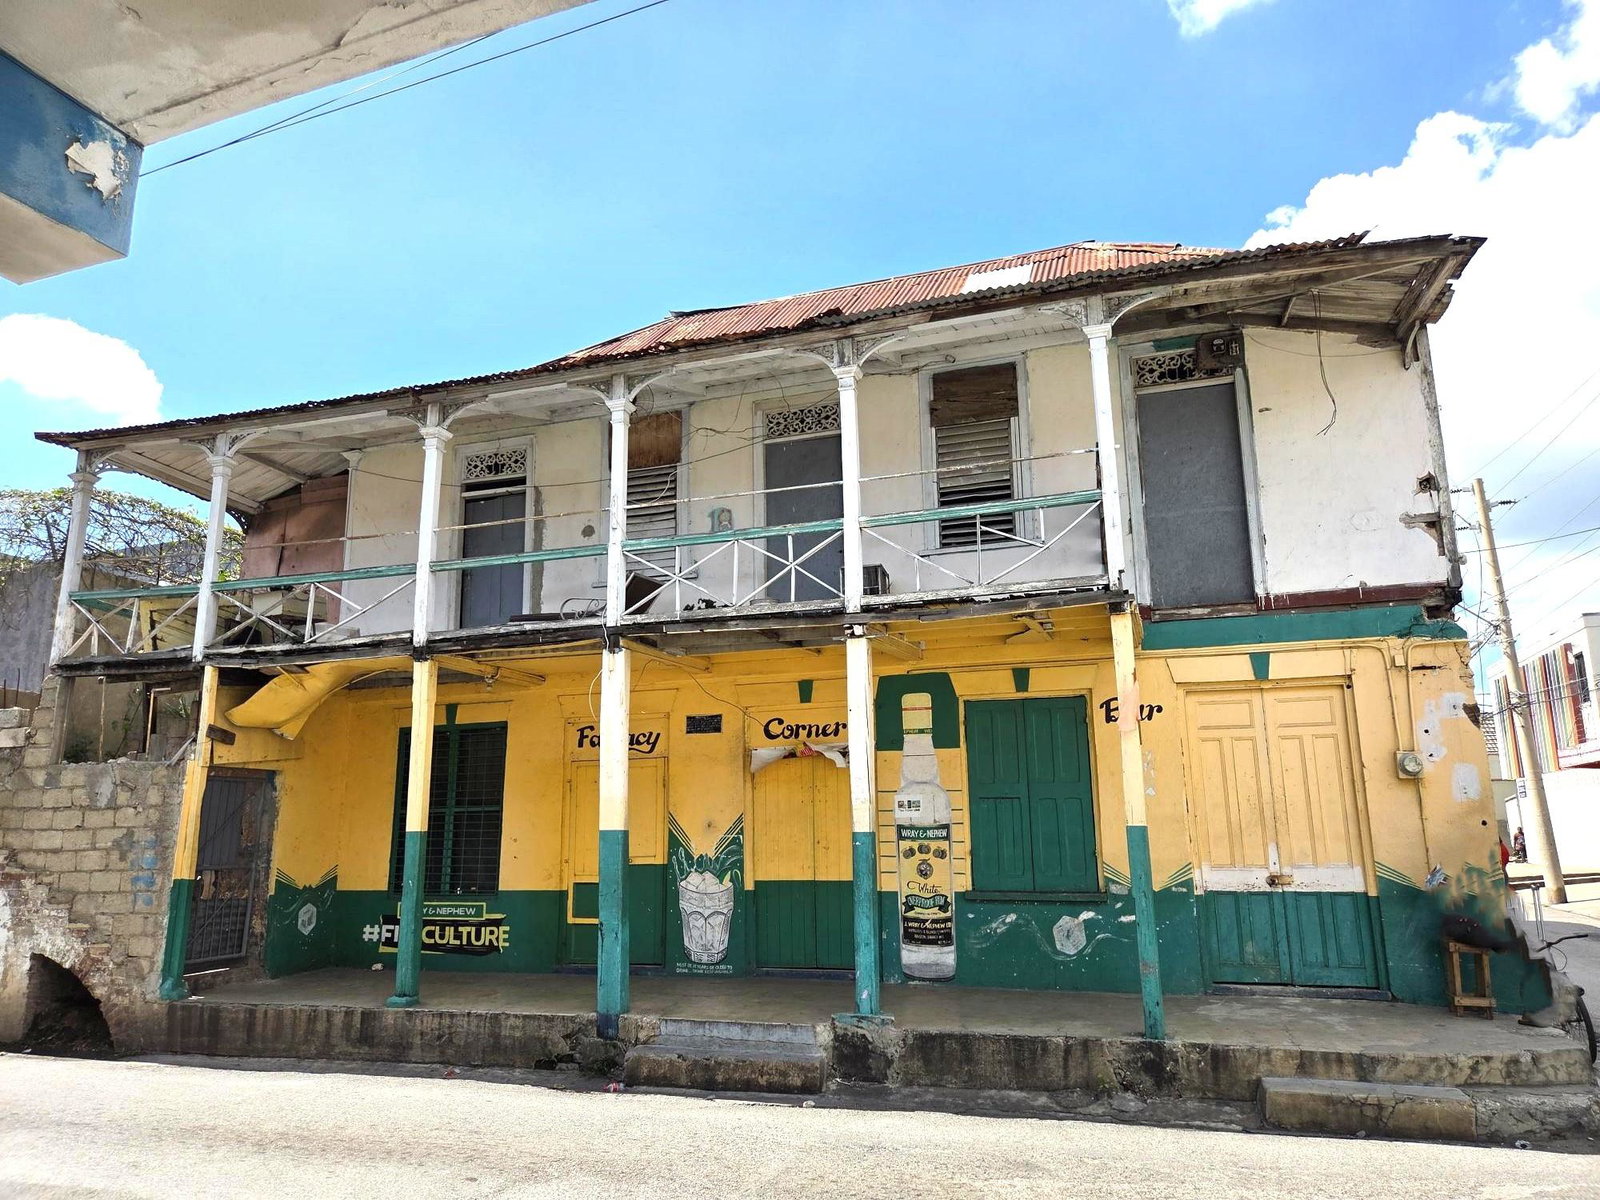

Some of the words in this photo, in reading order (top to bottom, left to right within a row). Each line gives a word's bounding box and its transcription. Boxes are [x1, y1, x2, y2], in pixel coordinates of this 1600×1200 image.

[763, 717, 848, 740] Corner
[900, 828, 919, 838] WRAY
[919, 829, 926, 838] &
[926, 828, 948, 838] NEPHEW
[906, 880, 942, 893] White
[436, 907, 476, 916] NEPHEW
